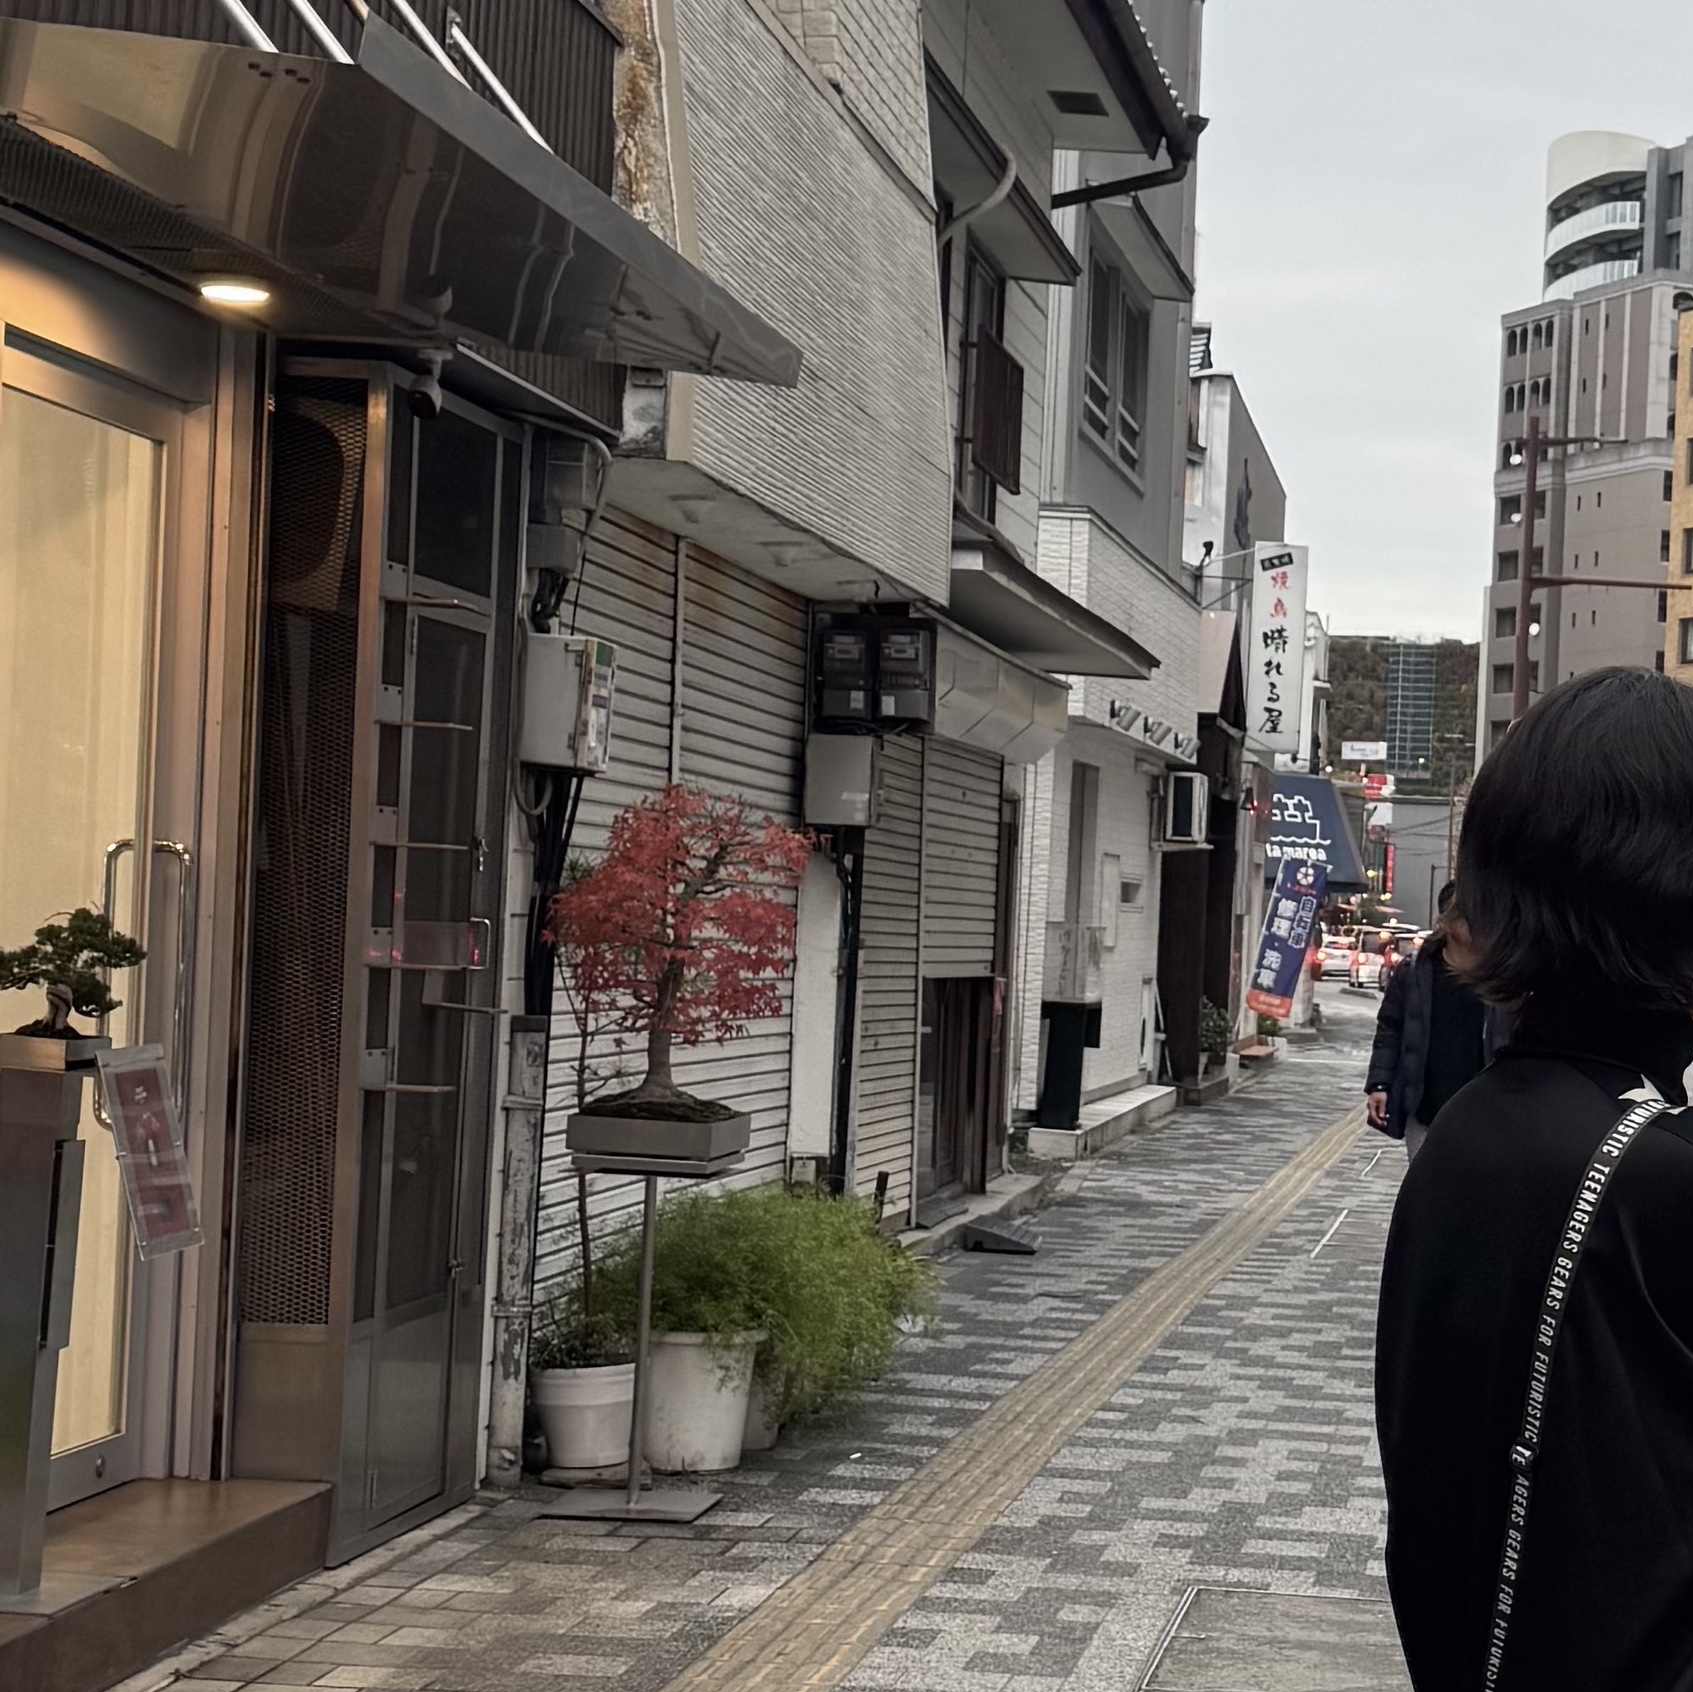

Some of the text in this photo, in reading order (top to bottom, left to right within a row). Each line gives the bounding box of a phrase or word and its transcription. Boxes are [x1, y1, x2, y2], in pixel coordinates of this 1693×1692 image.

[1259, 625, 1289, 733] 晴れる屋
[1601, 1100, 1671, 1158] UTURISTIC
[1563, 1162, 1611, 1253] TEENAGERS
[1546, 1256, 1573, 1310] GEARS
[1538, 1314, 1556, 1347] FOR
[1524, 1351, 1549, 1443] FUTURISTIC
[1502, 1529, 1522, 1580] GEARS
[1497, 1584, 1514, 1614] FOR
